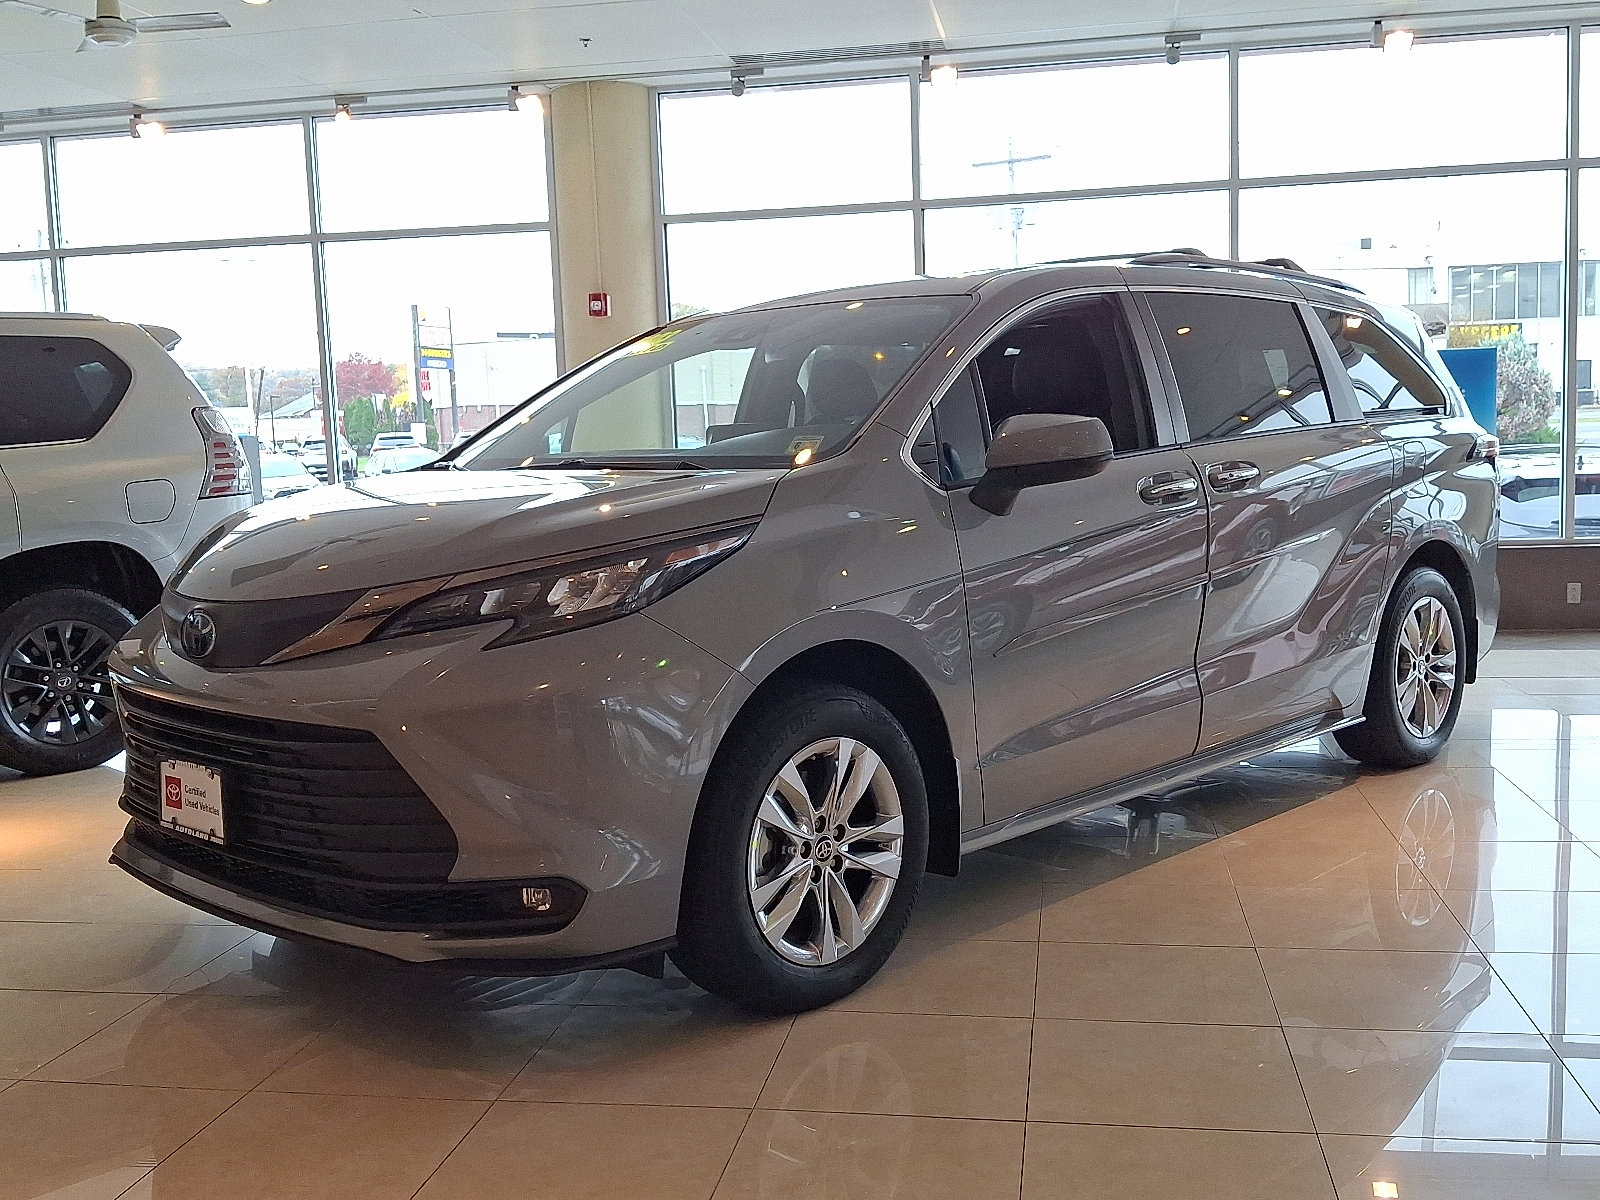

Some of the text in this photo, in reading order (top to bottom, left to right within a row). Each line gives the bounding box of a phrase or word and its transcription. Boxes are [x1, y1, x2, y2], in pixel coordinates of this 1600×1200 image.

[184, 784, 206, 798] Certified
[184, 798, 220, 816] Used Vehicles
[175, 825, 209, 840] AUTOLAND
